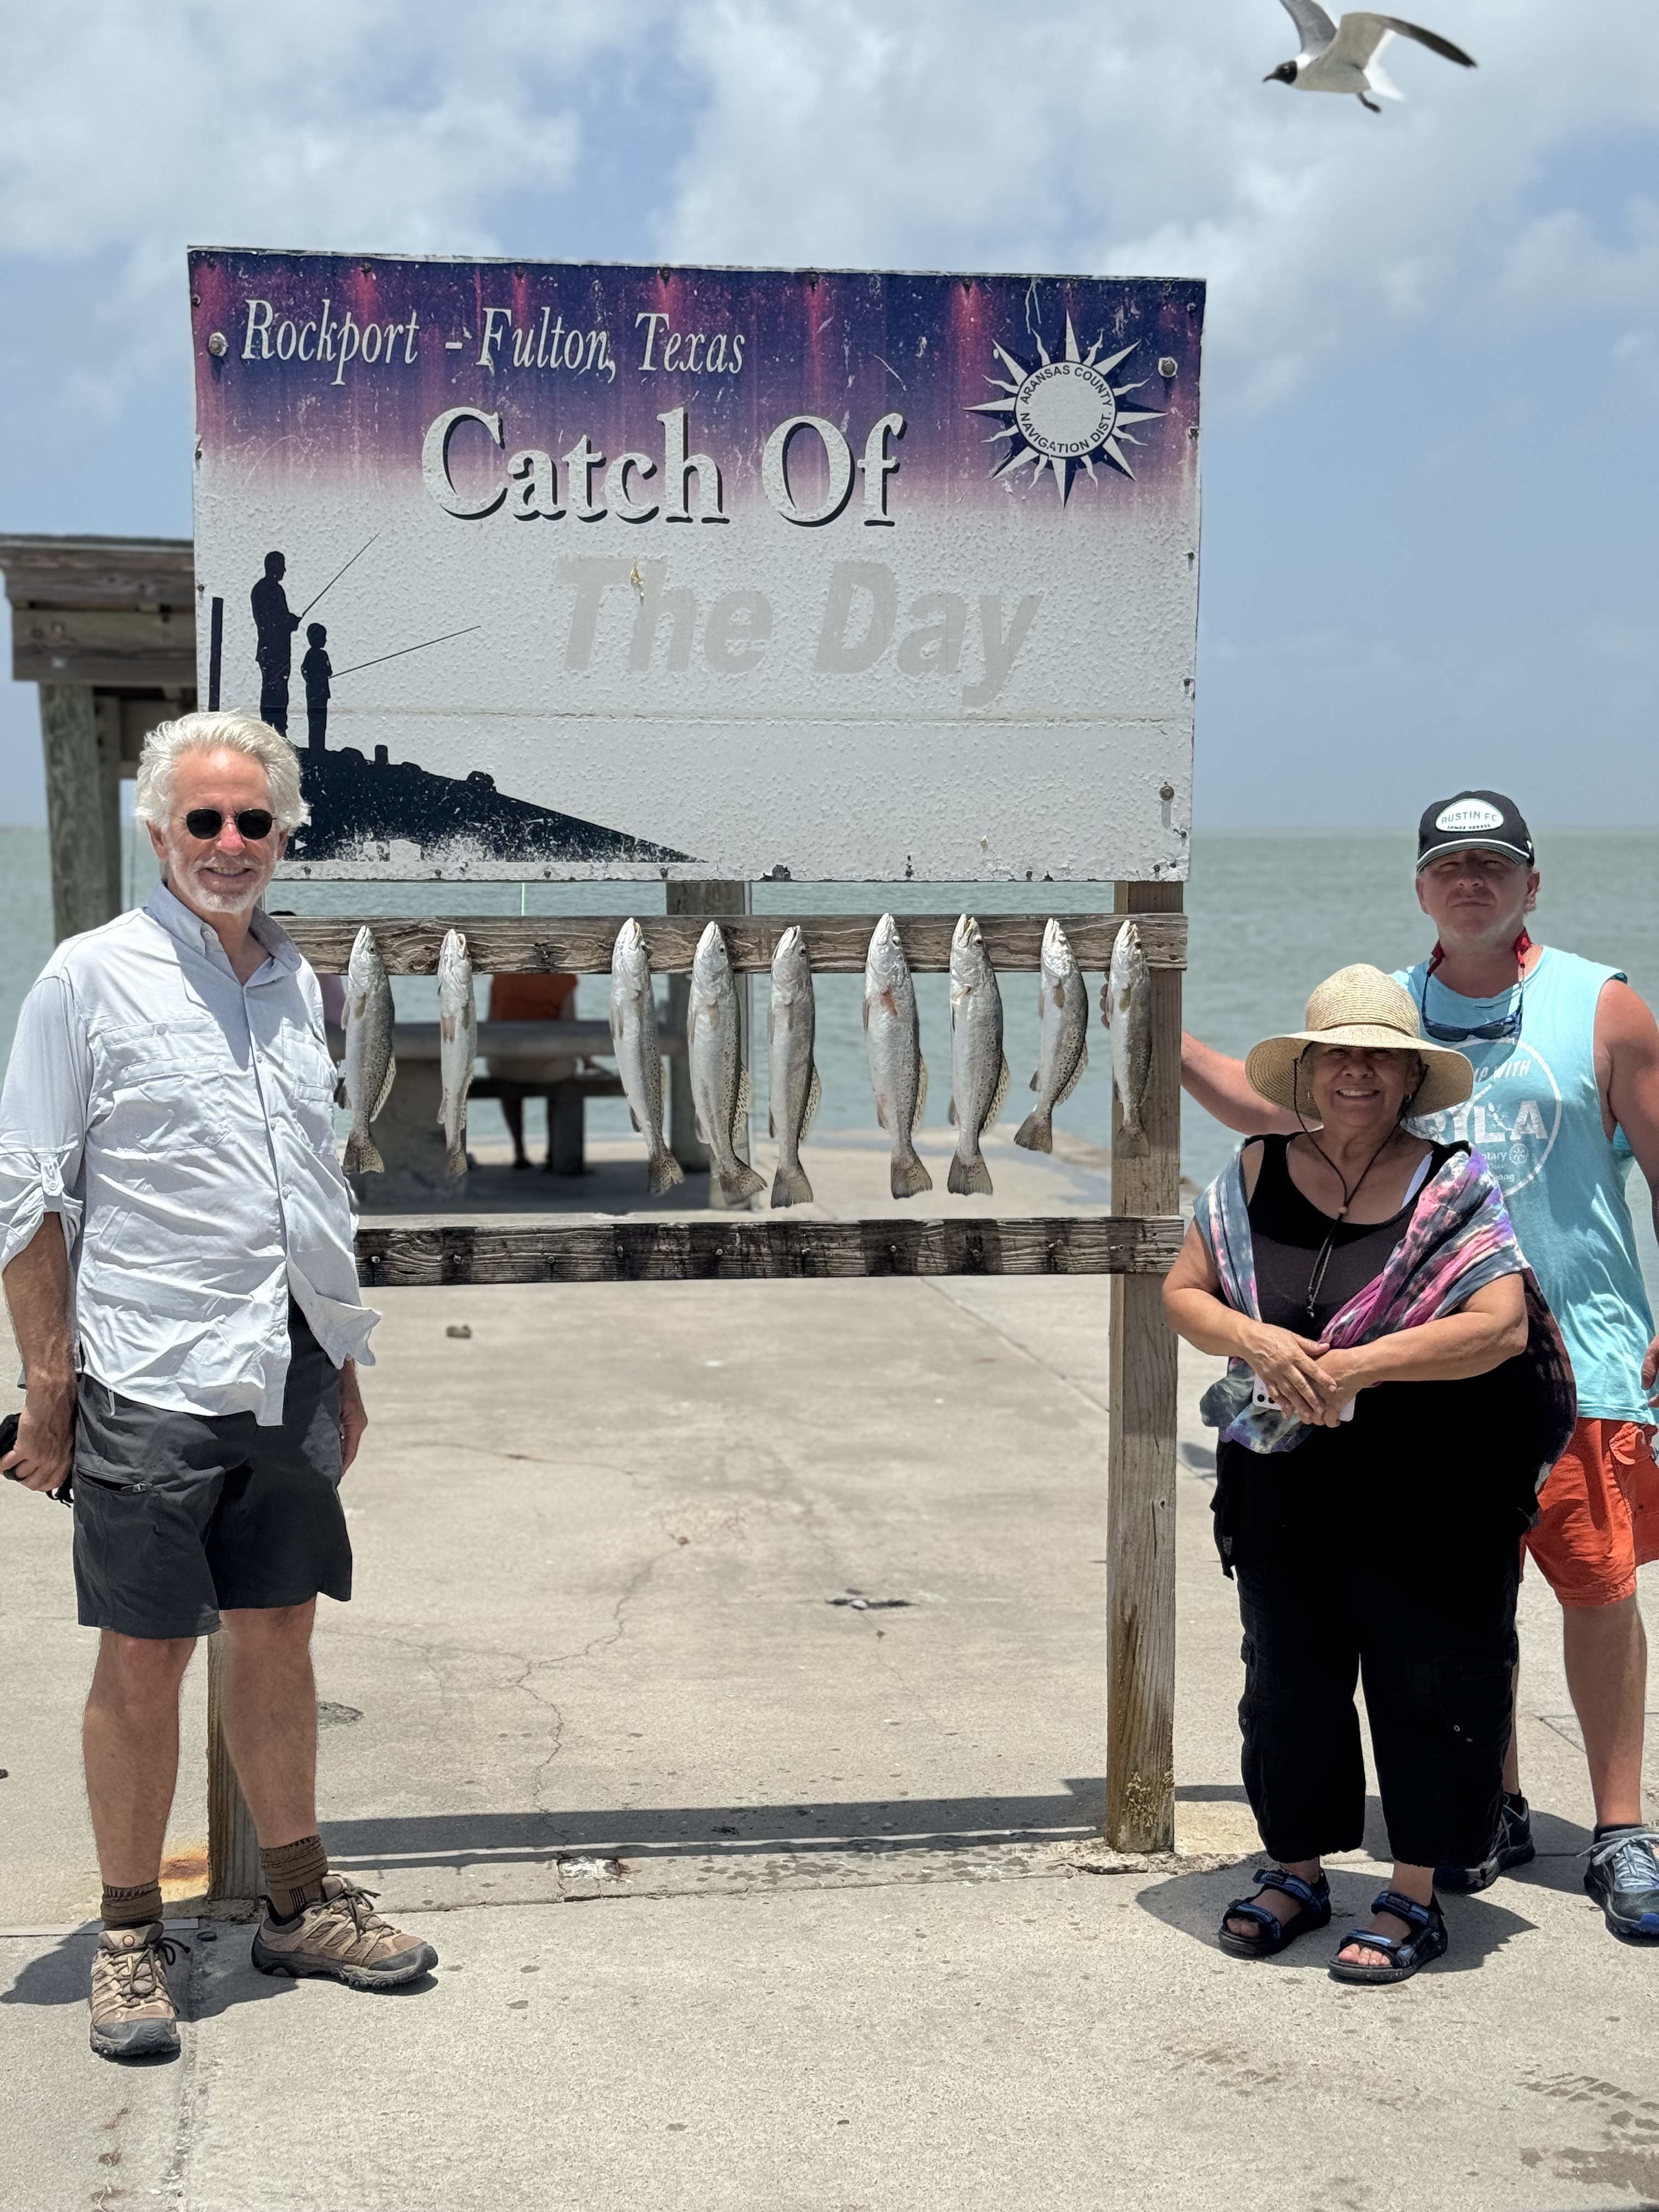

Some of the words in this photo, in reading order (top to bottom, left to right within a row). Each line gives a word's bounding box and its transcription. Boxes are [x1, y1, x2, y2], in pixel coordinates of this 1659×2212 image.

[240, 298, 420, 386] Rockport
[475, 306, 616, 383] Fulton,
[635, 312, 745, 374] Texas
[1019, 364, 1070, 405] ARANSAS
[1074, 366, 1113, 408] COUNTY
[1020, 412, 1090, 454] NAVIGATION
[1090, 411, 1113, 443] DIST.
[421, 406, 730, 525] Catch
[761, 413, 907, 528] Of
[553, 556, 774, 676] The
[812, 561, 1045, 708] Day
[1441, 811, 1481, 825] AUSTIN
[1485, 812, 1498, 822] FC
[1493, 1059, 1531, 1080] WITH
